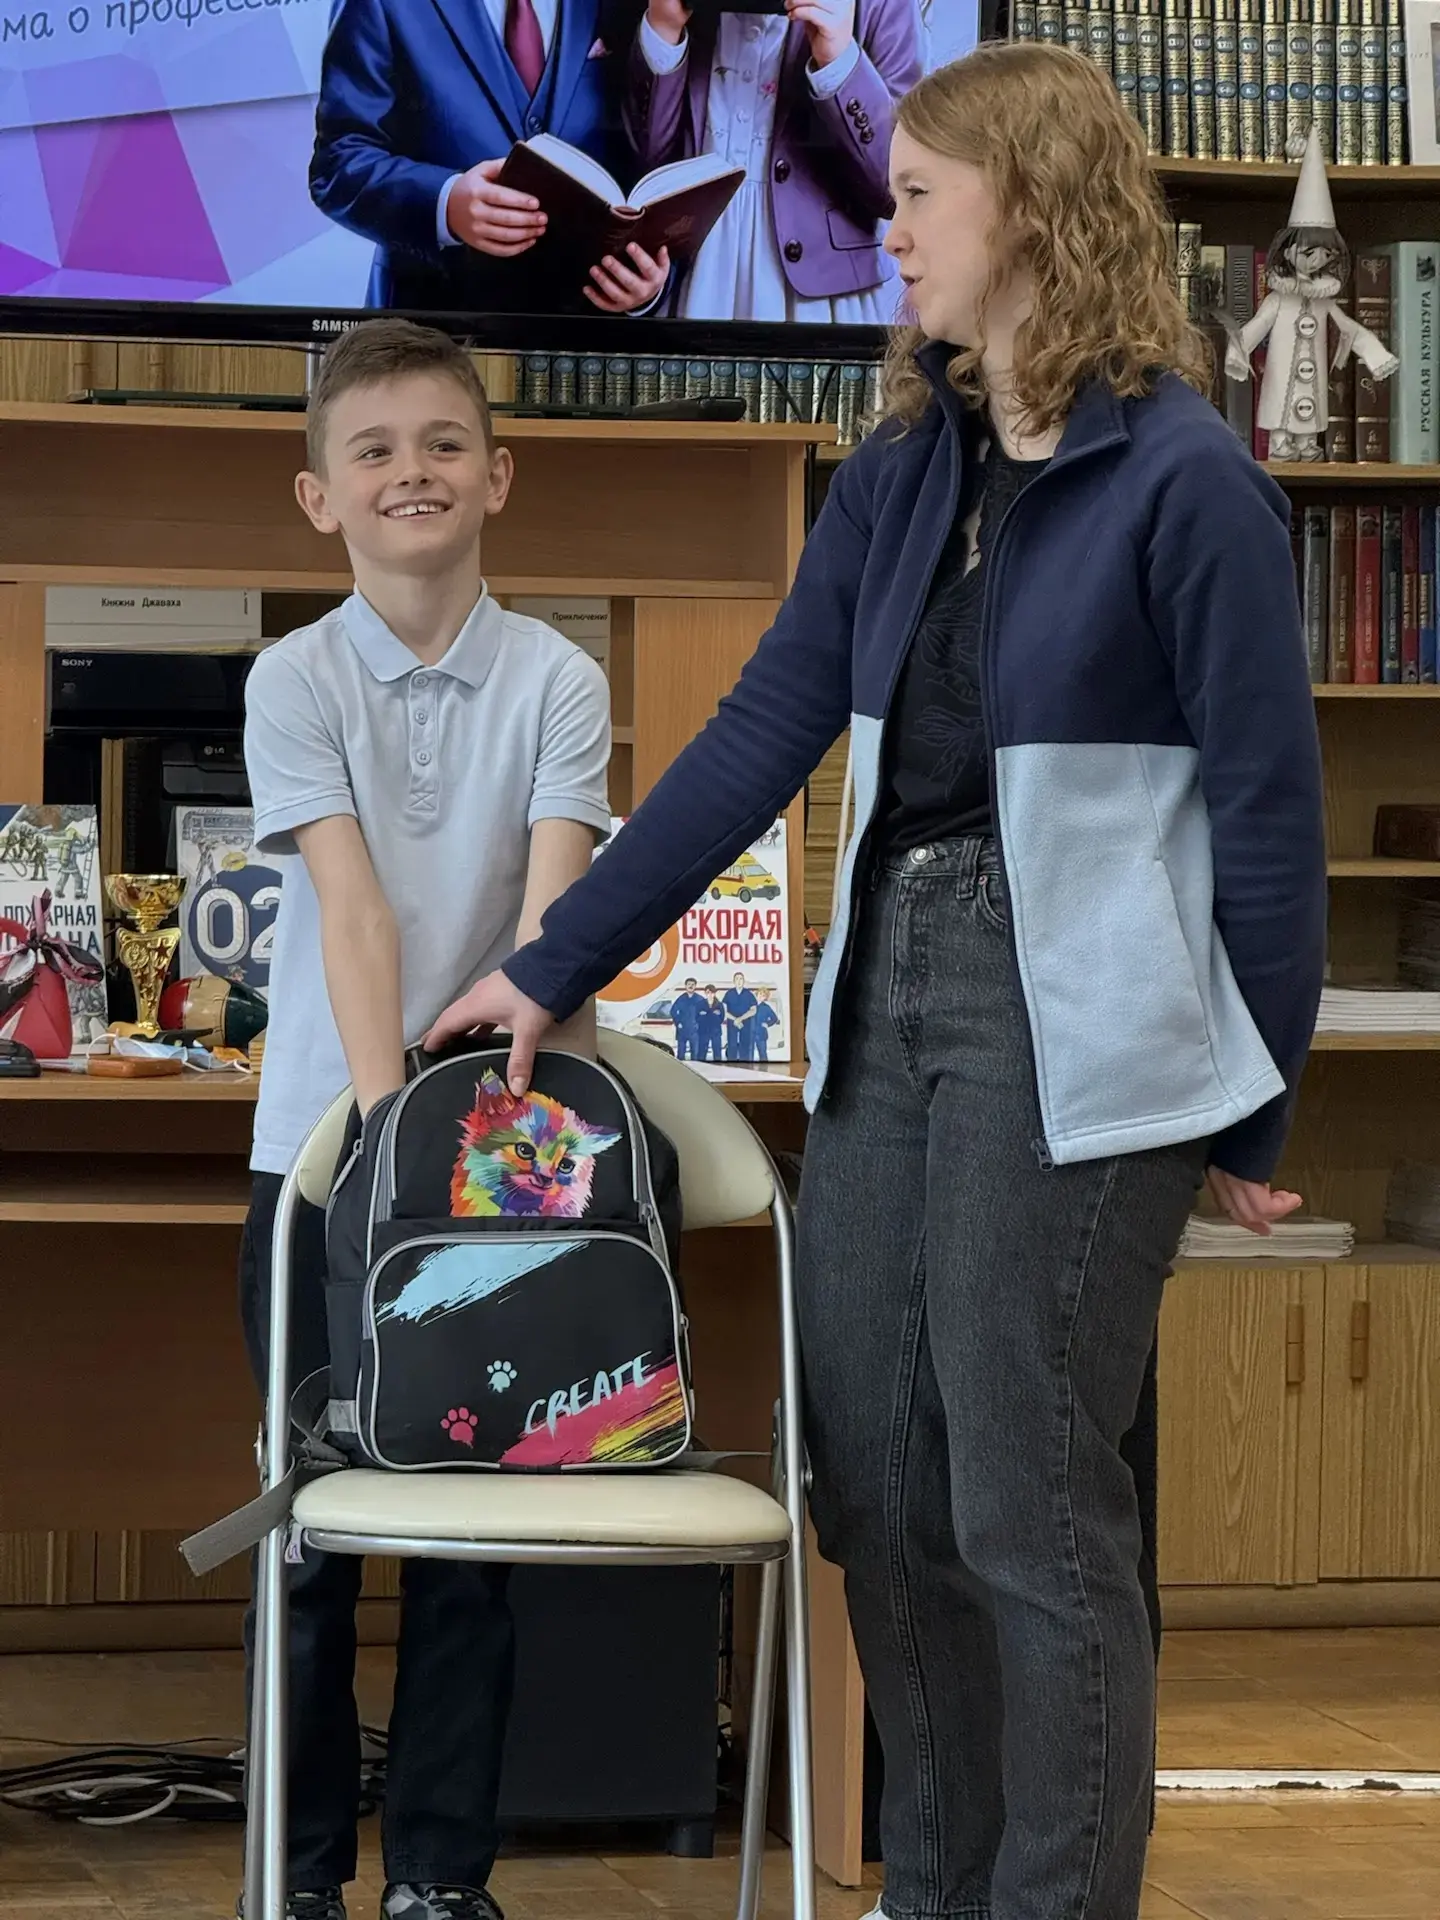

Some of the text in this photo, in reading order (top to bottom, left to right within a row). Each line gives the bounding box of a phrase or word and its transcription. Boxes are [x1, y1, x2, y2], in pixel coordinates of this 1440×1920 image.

[67, 6, 90, 34] о
[1420, 291, 1431, 433] РУССКАЯ КУЛЬТУРА
[101, 597, 181, 608] Книжна Джаваха
[61, 658, 93, 667] SONY
[196, 886, 282, 965] 02
[682, 908, 782, 940] СКОРАЯ
[682, 942, 784, 964] ПОМОЩЬ
[524, 1350, 657, 1440] CREATE
